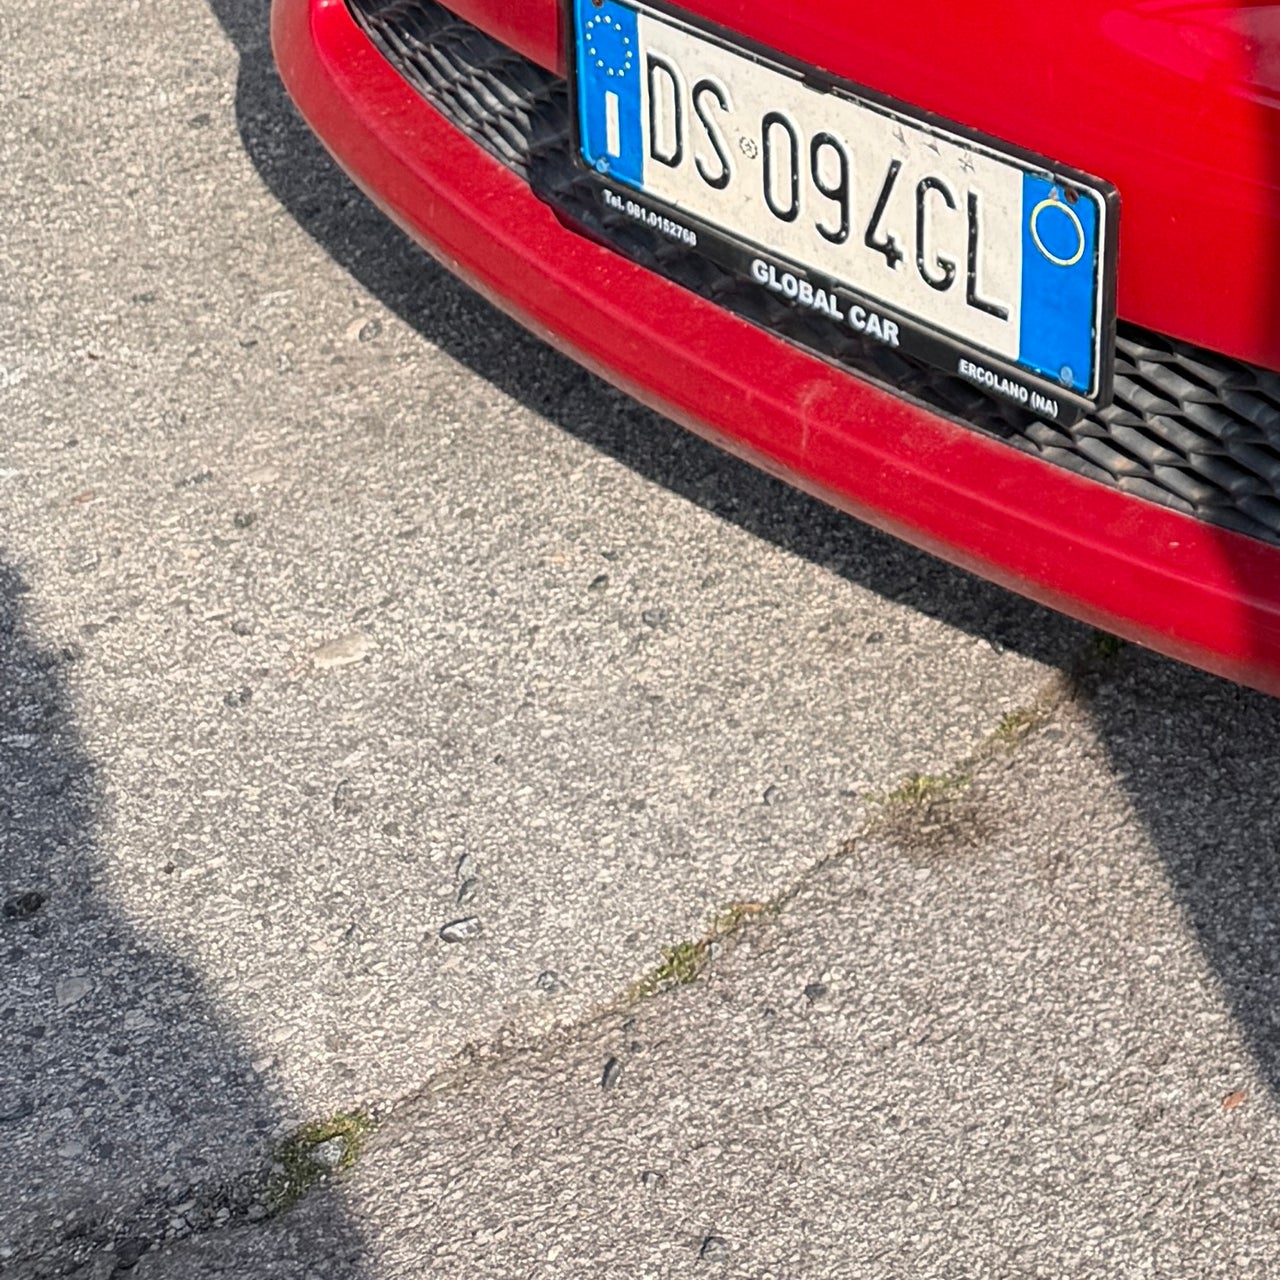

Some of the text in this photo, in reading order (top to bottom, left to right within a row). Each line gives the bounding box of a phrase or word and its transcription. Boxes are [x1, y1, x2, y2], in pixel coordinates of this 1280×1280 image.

[601, 188, 625, 211] Tel.
[647, 51, 1010, 322] DS 094GL
[752, 258, 900, 347] GLOBAL CAR
[958, 358, 1058, 419] ERCOLANO (NA)
